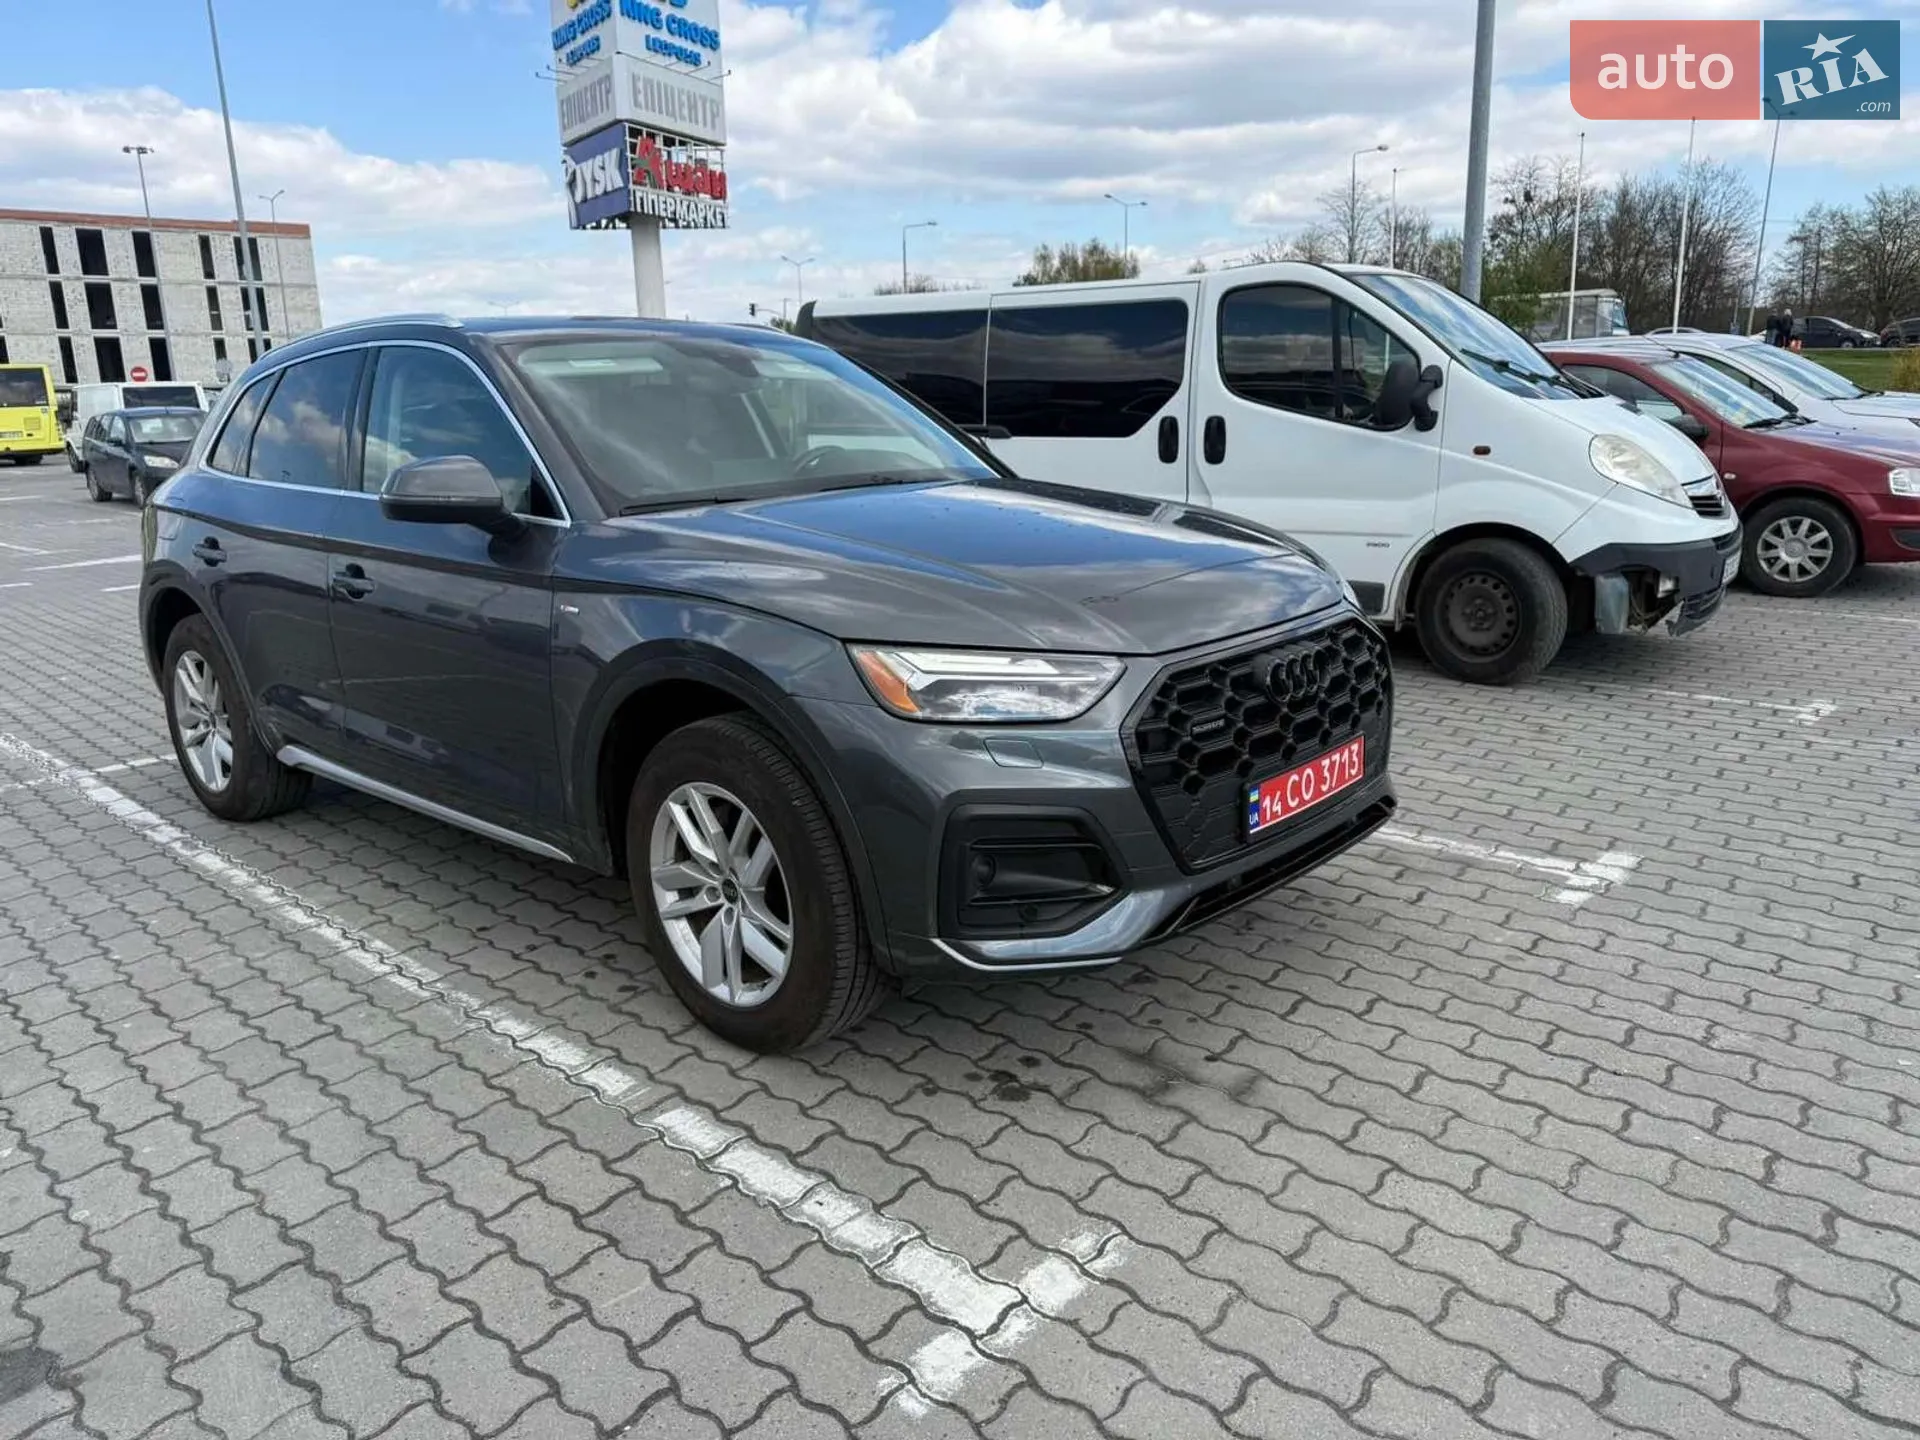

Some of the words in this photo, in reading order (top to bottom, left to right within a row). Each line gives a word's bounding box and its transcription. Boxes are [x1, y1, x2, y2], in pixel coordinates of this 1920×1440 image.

[666, 13, 720, 51] CROSS
[631, 72, 721, 131] ЕПІЦЕНТР
[574, 147, 624, 205] JYSK
[1262, 790, 1282, 821] 14
[1286, 767, 1315, 808] CO
[1320, 742, 1359, 793] 3713
[1249, 811, 1259, 825] UA
